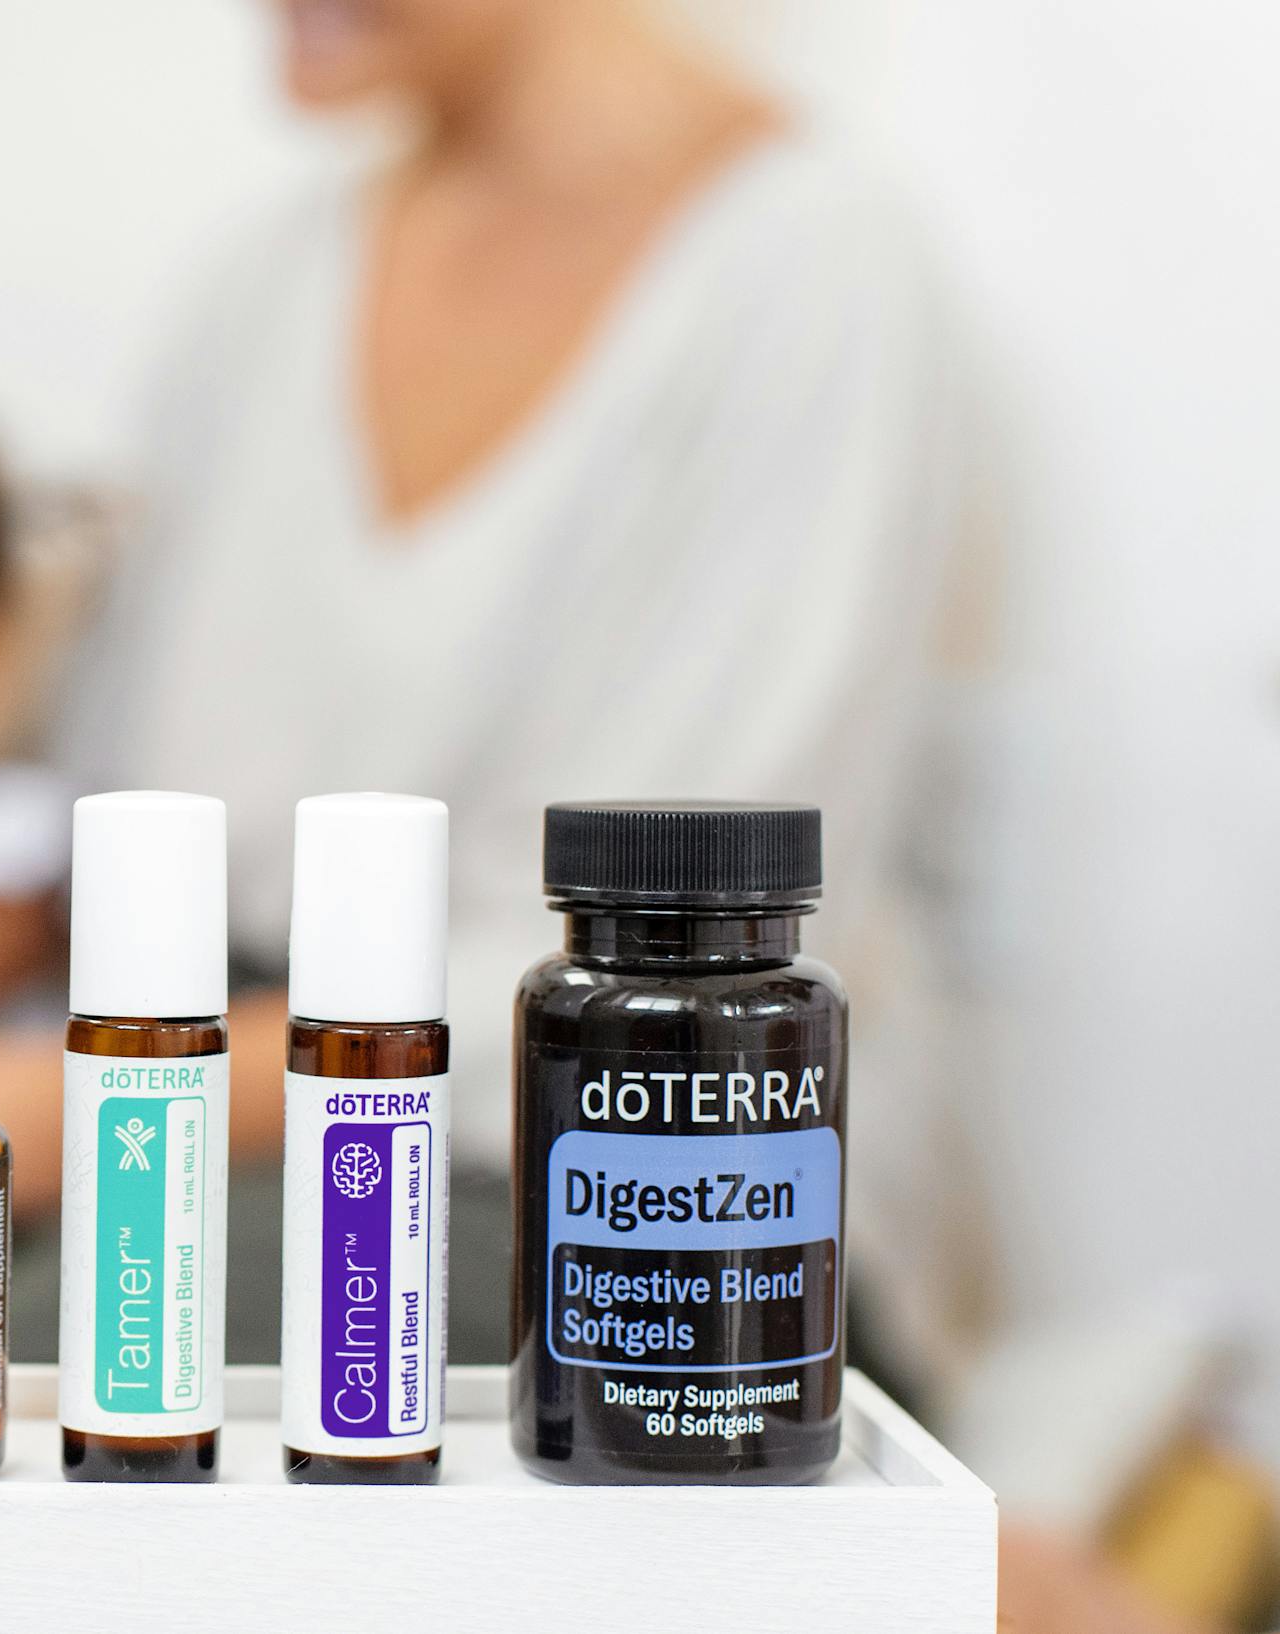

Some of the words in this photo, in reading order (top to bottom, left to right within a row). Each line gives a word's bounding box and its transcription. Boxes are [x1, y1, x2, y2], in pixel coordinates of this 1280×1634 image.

[185, 1120, 195, 1139] ON
[184, 1143, 195, 1174] ROLL
[410, 1145, 420, 1165] ON
[184, 1177, 194, 1197] mL
[410, 1169, 420, 1200] ROLL
[184, 1200, 194, 1214] 10
[410, 1200, 419, 1221] mL
[409, 1223, 419, 1239] 10
[176, 1244, 194, 1300] Blend
[564, 1262, 710, 1308] Digestive
[720, 1263, 803, 1303] Blend
[402, 1291, 419, 1347] Blend
[563, 1308, 695, 1357] Softgels
[175, 1307, 195, 1398] Digestive
[401, 1354, 418, 1423] Restful
[604, 1381, 679, 1408] Dietary
[684, 1379, 799, 1411] Supplement
[646, 1414, 675, 1435] 60
[680, 1412, 764, 1439] Softgels
